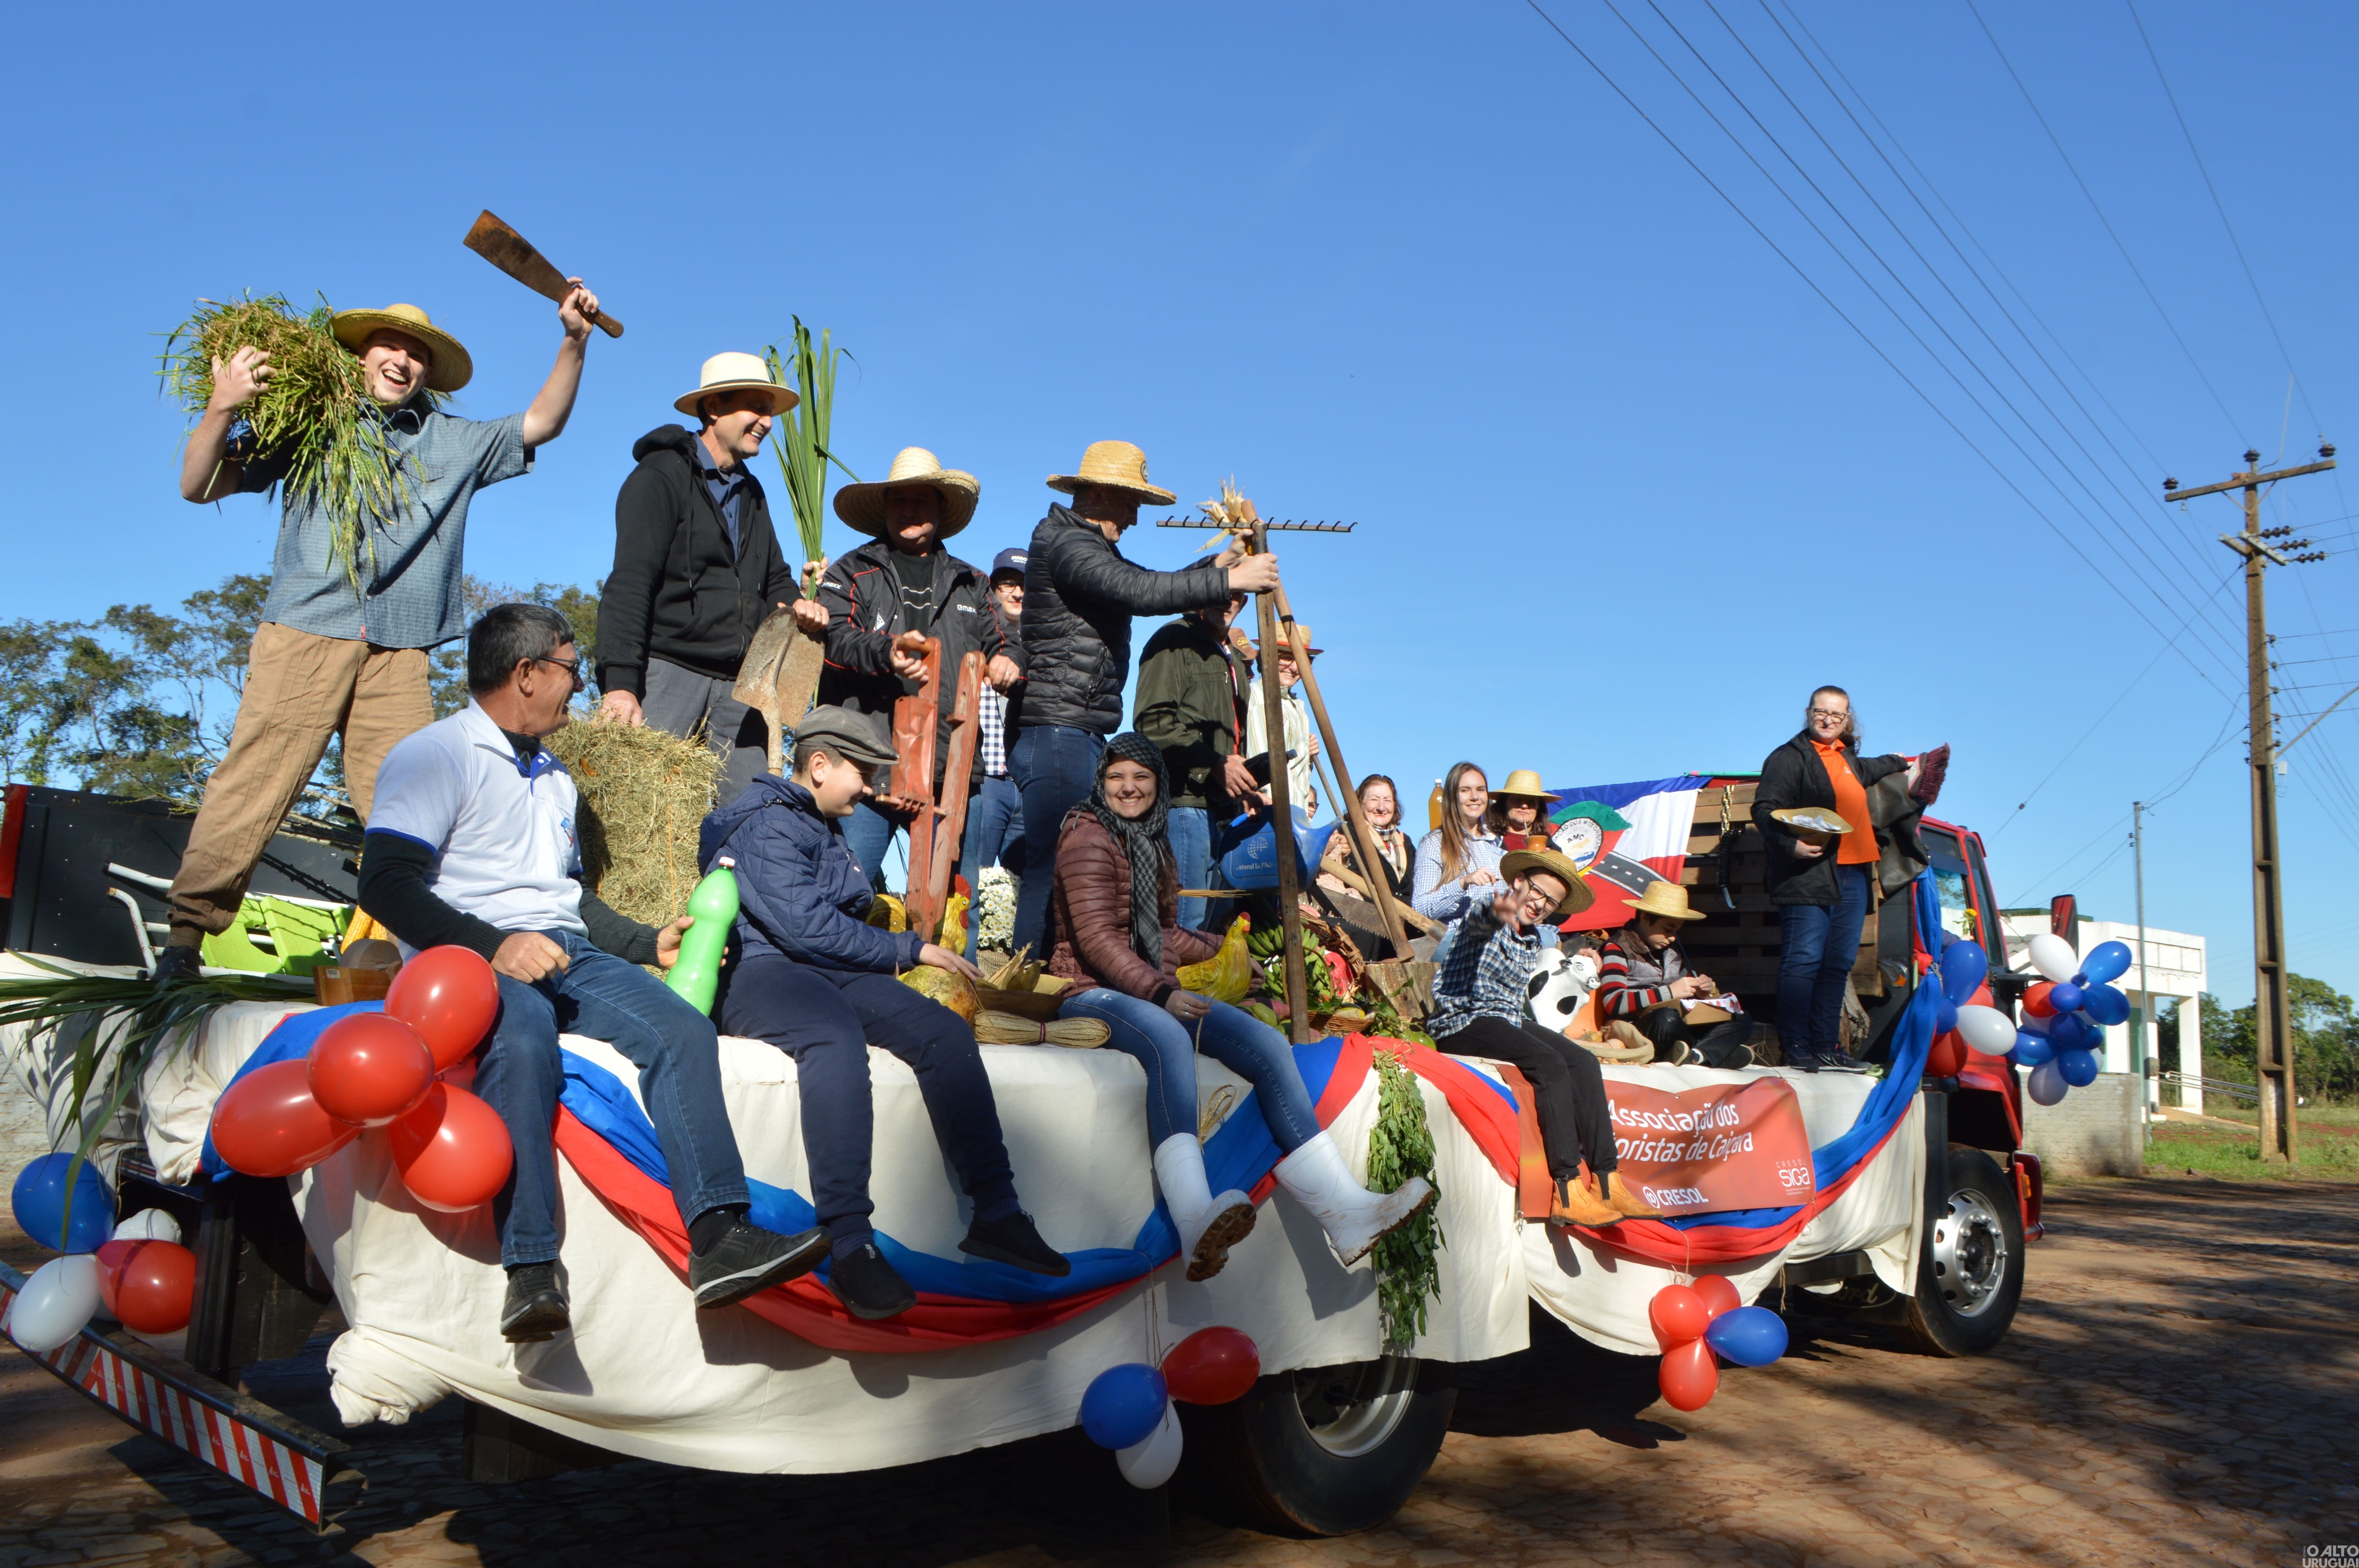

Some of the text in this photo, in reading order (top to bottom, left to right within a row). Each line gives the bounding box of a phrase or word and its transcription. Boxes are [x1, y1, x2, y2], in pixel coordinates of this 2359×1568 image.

[1567, 833, 1585, 843] AMC
[1608, 1098, 1739, 1138] Associação dos
[1613, 1131, 1754, 1162] oristas de Caiçara
[1776, 1159, 1806, 1169] CRESOL
[1657, 1188, 1709, 1206] CRESOL
[1836, 1283, 1879, 1304] ord
